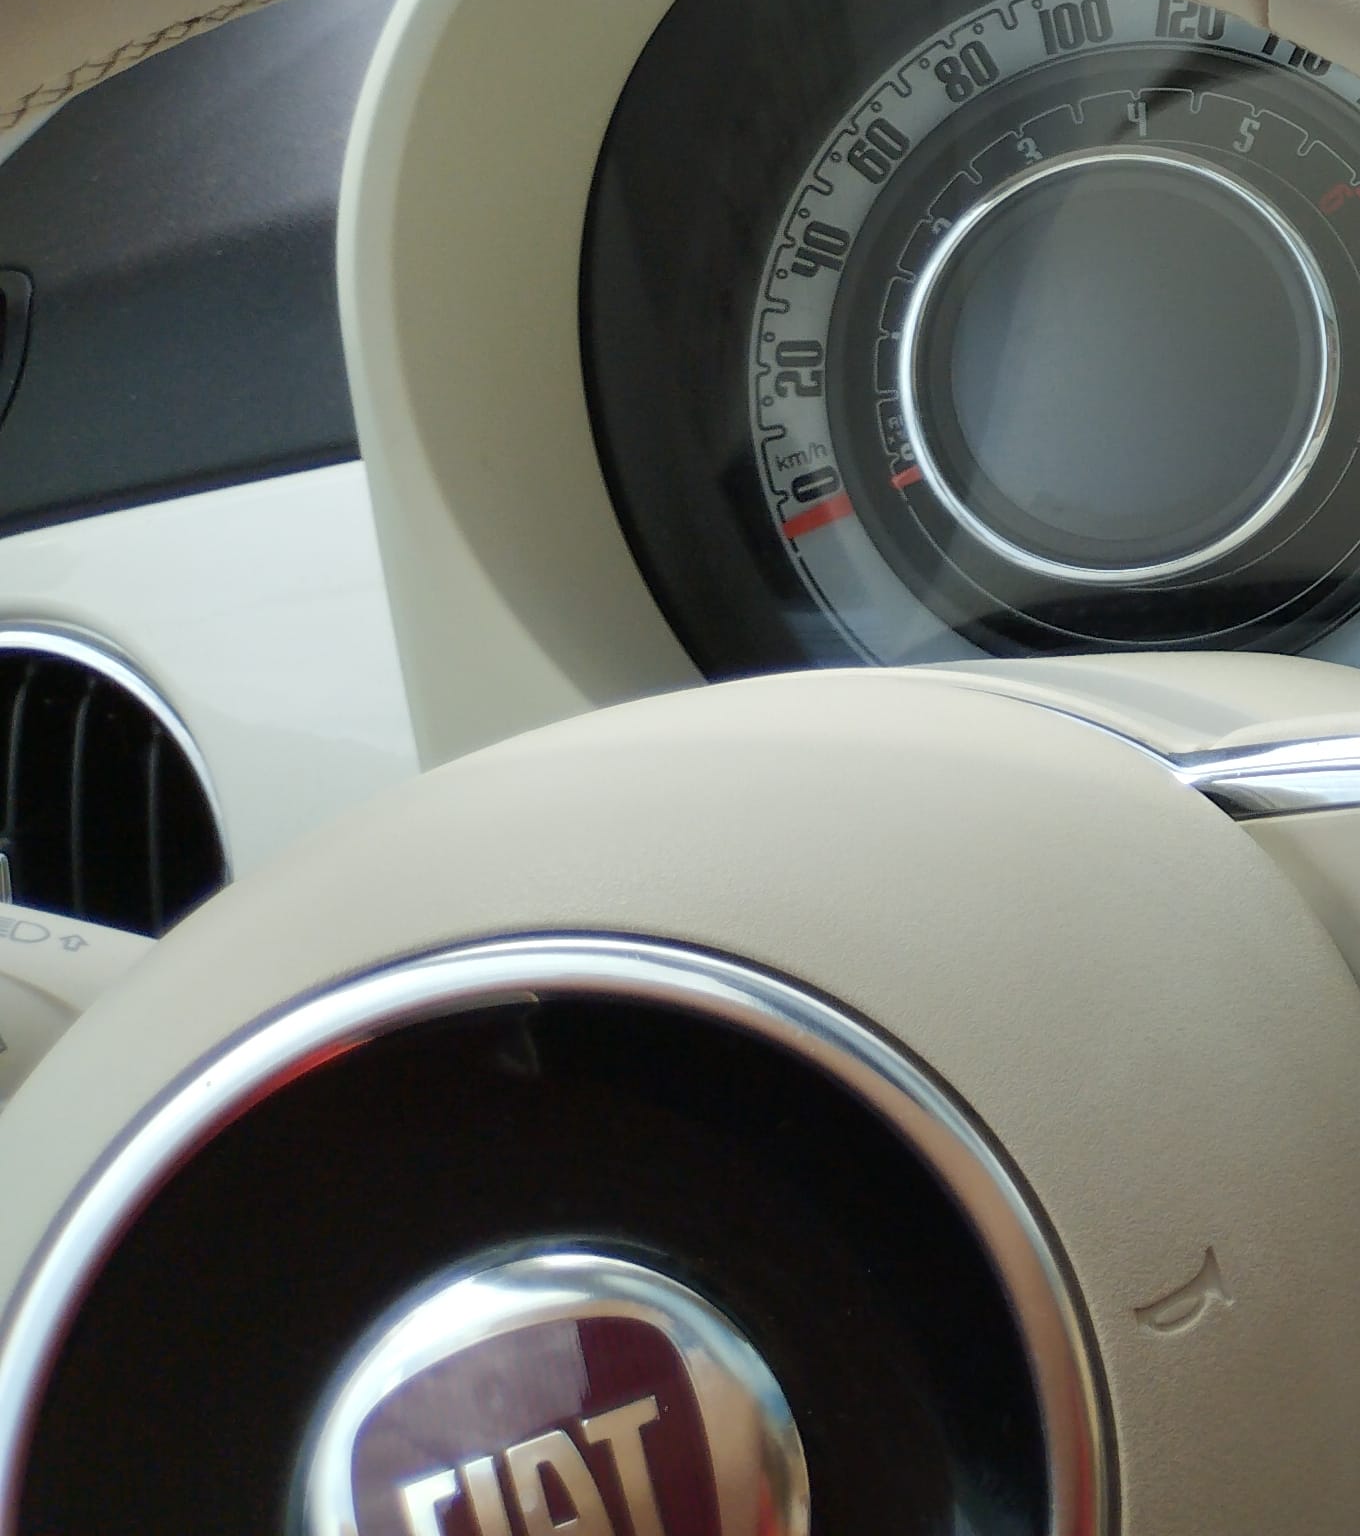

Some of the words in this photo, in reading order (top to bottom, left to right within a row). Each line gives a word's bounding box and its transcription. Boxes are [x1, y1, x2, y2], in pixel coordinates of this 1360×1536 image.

[934, 39, 1000, 105] 80
[846, 116, 911, 185] 60
[1232, 117, 1261, 153] 5
[790, 219, 852, 280] 40
[774, 339, 824, 399] 20
[775, 442, 829, 472] km/h
[790, 464, 839, 504] 0
